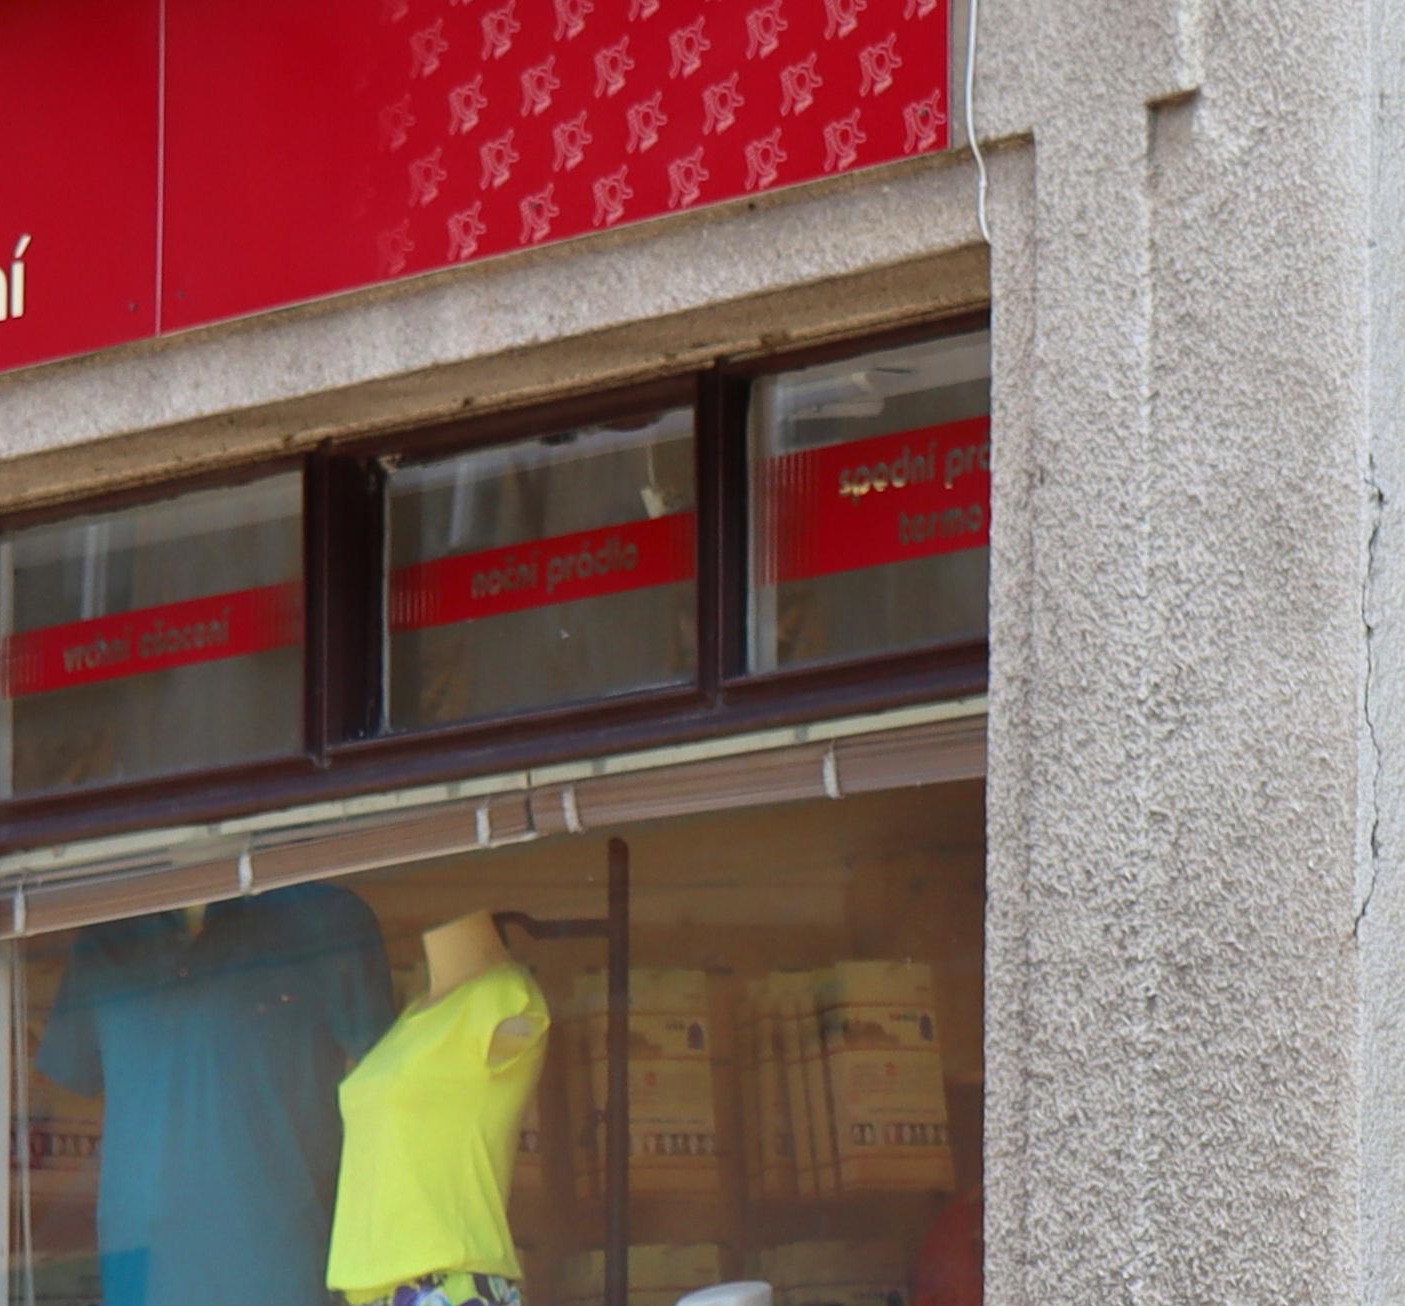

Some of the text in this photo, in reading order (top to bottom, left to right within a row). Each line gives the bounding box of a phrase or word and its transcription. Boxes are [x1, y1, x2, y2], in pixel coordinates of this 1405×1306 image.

[839, 440, 938, 508] spodní
[899, 503, 984, 545] termo
[471, 536, 639, 600] noční prádlo
